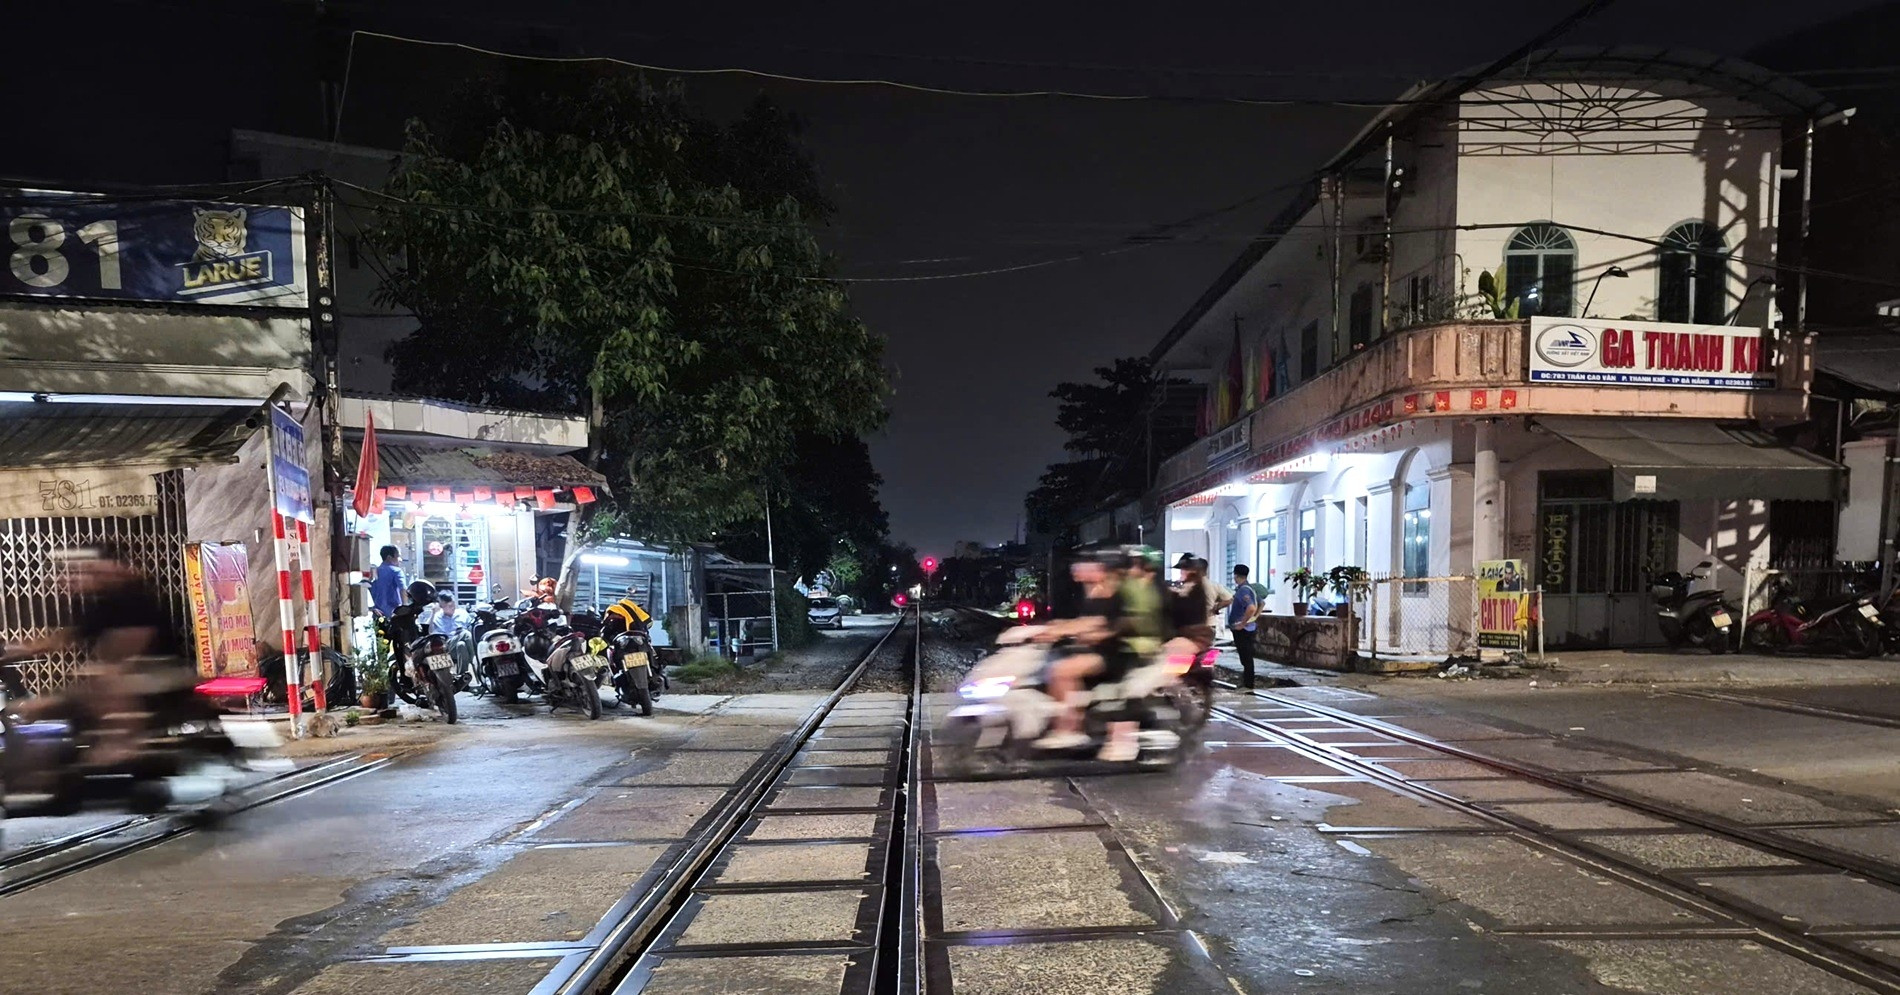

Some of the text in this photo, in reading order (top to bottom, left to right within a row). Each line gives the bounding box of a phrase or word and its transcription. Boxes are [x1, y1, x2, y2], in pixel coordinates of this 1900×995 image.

[182, 256, 264, 288] LARUE
[1601, 328, 1635, 368] GA
[1642, 331, 1724, 372] THANH
[39, 479, 96, 511] 781
[196, 600, 209, 633] LANG
[1482, 588, 1498, 630] CẮT
[200, 634, 213, 673] KHOAI
